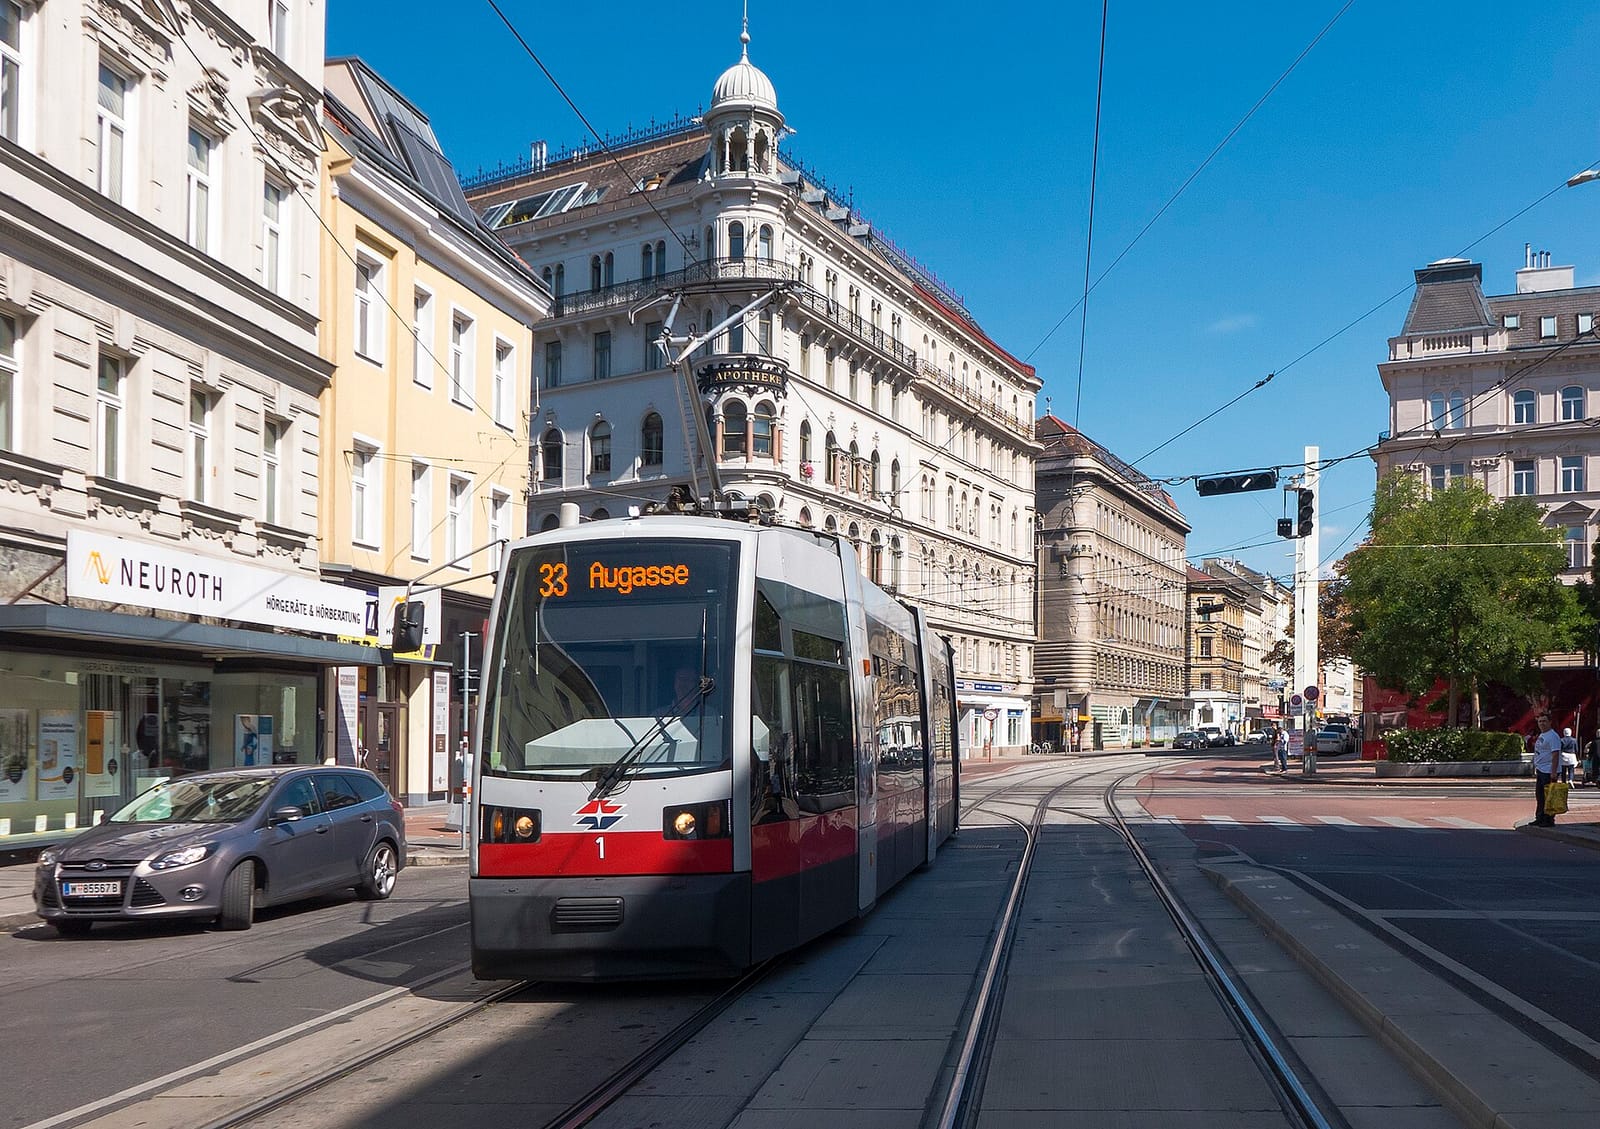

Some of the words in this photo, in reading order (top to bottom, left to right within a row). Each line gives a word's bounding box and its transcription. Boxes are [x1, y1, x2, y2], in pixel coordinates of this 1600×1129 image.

[715, 370, 783, 385] APOTHEKE
[121, 558, 222, 602] NEUROTH
[539, 562, 569, 598] 33
[589, 561, 690, 595] Augasse
[265, 594, 308, 617] HÖRGERÄTE
[309, 604, 315, 617] &
[315, 603, 361, 625] HÖRBERATUNG
[594, 836, 605, 859] 1
